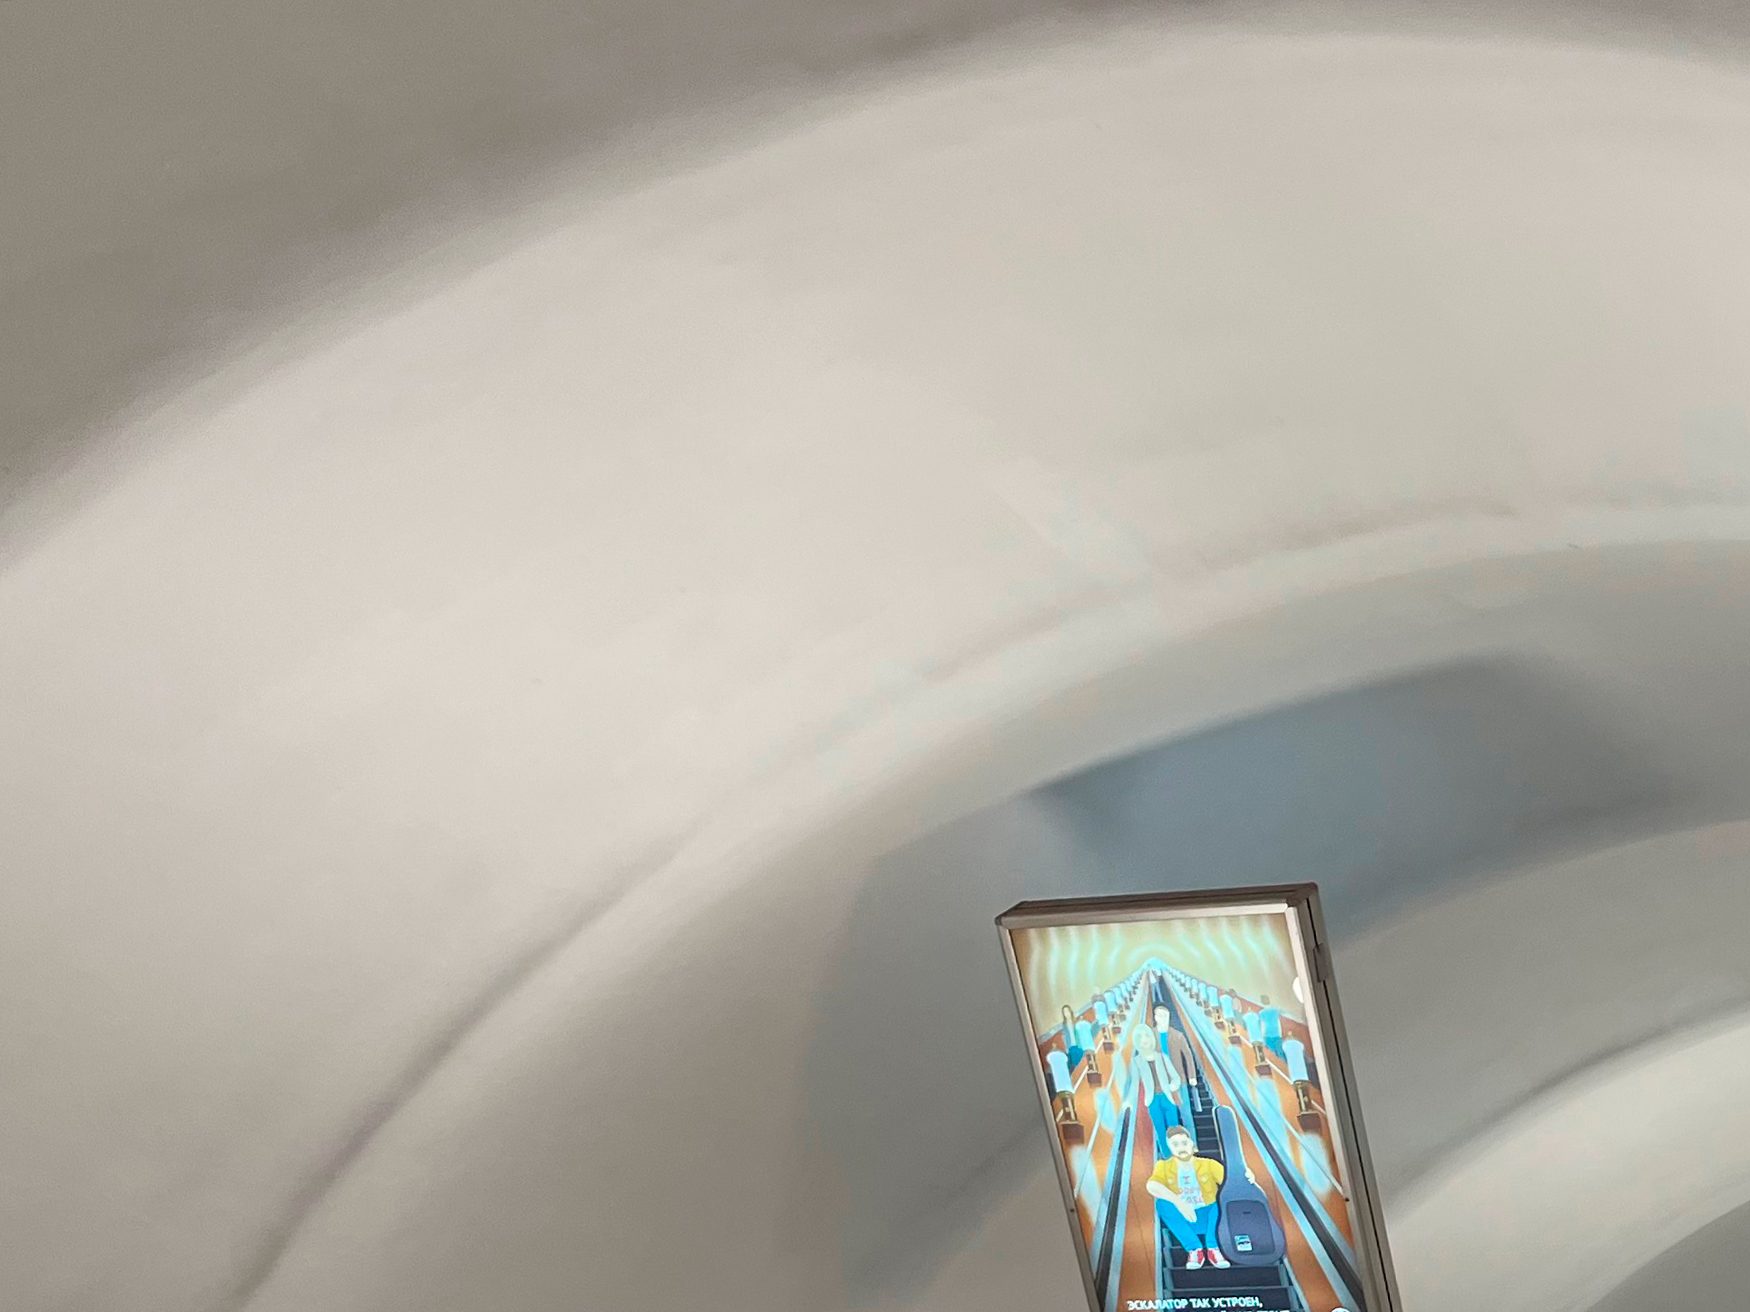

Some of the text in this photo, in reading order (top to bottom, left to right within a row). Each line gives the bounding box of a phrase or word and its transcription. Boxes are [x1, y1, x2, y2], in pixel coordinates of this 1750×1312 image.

[1126, 1297, 1263, 1311] ЭСКАЛАТОР ТАК УСТРОЕН,
